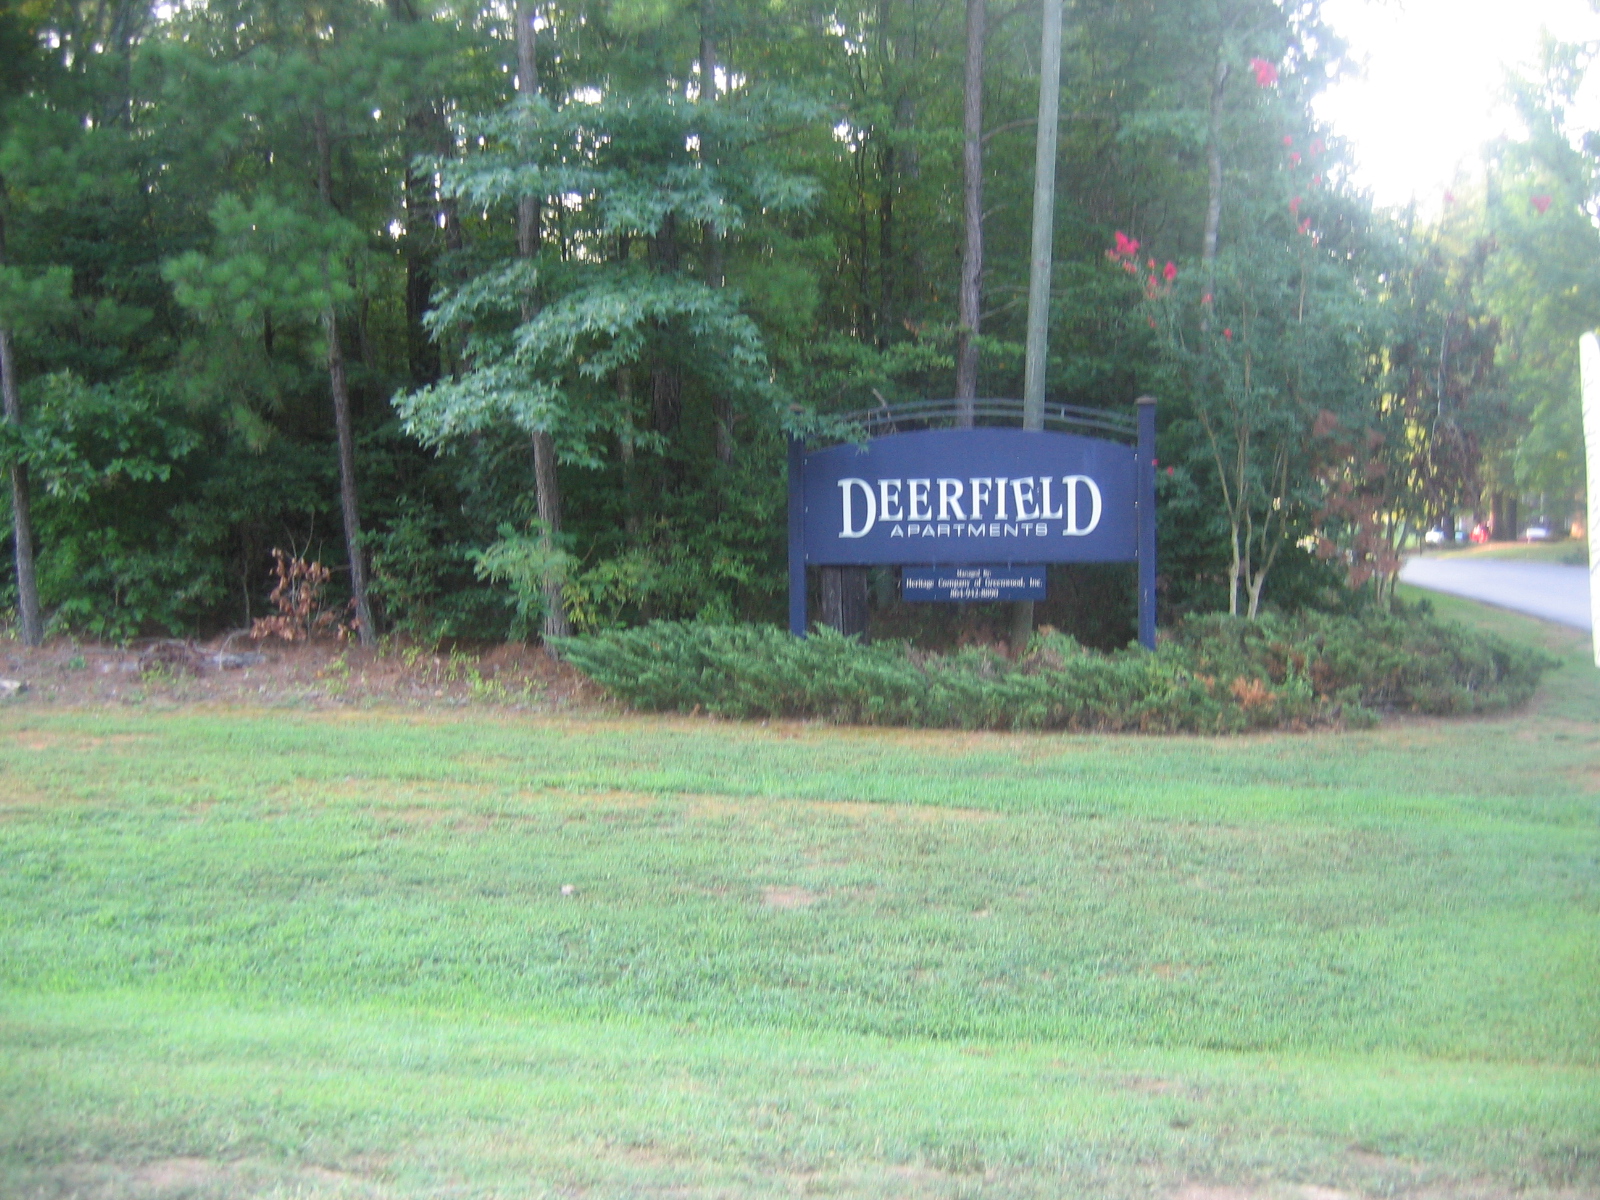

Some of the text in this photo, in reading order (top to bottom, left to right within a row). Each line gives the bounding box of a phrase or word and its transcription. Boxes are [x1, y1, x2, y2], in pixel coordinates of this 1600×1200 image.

[837, 474, 1102, 539] DEERFIELD
[890, 522, 1048, 538] APARTMENTS
[906, 577, 934, 590] Heritage
[938, 577, 971, 590] Company
[974, 577, 982, 589] of
